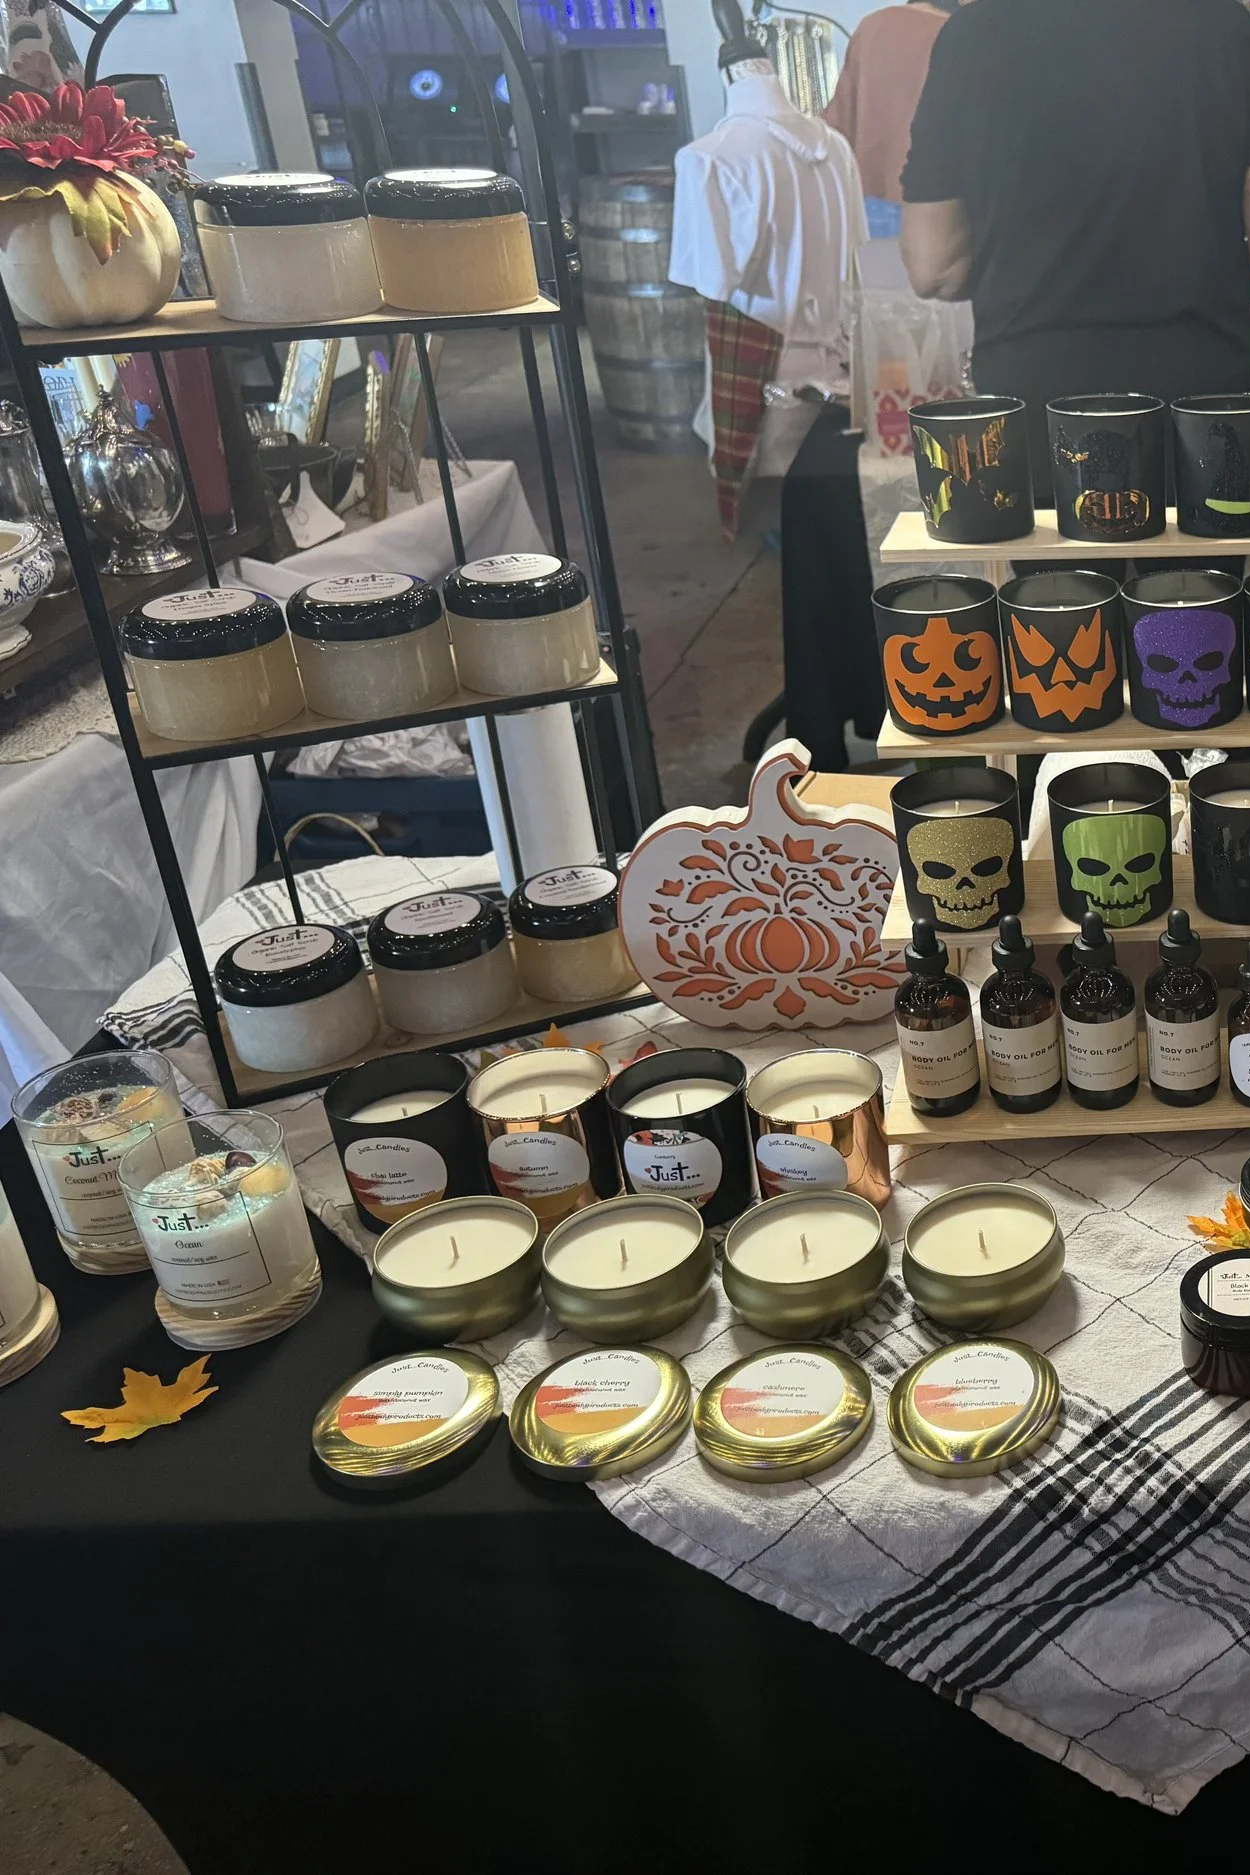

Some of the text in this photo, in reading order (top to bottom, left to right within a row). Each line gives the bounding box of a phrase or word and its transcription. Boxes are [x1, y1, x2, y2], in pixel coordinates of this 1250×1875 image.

[544, 870, 596, 886] Just...
[408, 896, 463, 912] Just...
[261, 929, 319, 946] Just...
[1068, 1044, 1088, 1054] BODY
[1090, 1048, 1104, 1056] OIL
[1106, 1045, 1122, 1054] FOR
[1160, 1045, 1182, 1054] BODY
[1185, 1046, 1199, 1054] OIL
[1200, 1041, 1214, 1052] FOR
[912, 1056, 934, 1064] BODY
[953, 1048, 968, 1060] FOR
[991, 1050, 1012, 1060] BODY
[1030, 1048, 1046, 1058] FOR
[376, 1144, 411, 1152] Candles
[69, 1146, 122, 1168] Just...
[650, 1162, 701, 1182] Just...
[157, 1213, 209, 1232] Just...
[174, 1240, 203, 1250] Ocean
[608, 1354, 640, 1364] Candles
[977, 1351, 1010, 1362] Candles
[418, 1362, 450, 1374] Candles
[790, 1358, 822, 1370] Candles
[373, 1390, 443, 1398] simply pumpkin
